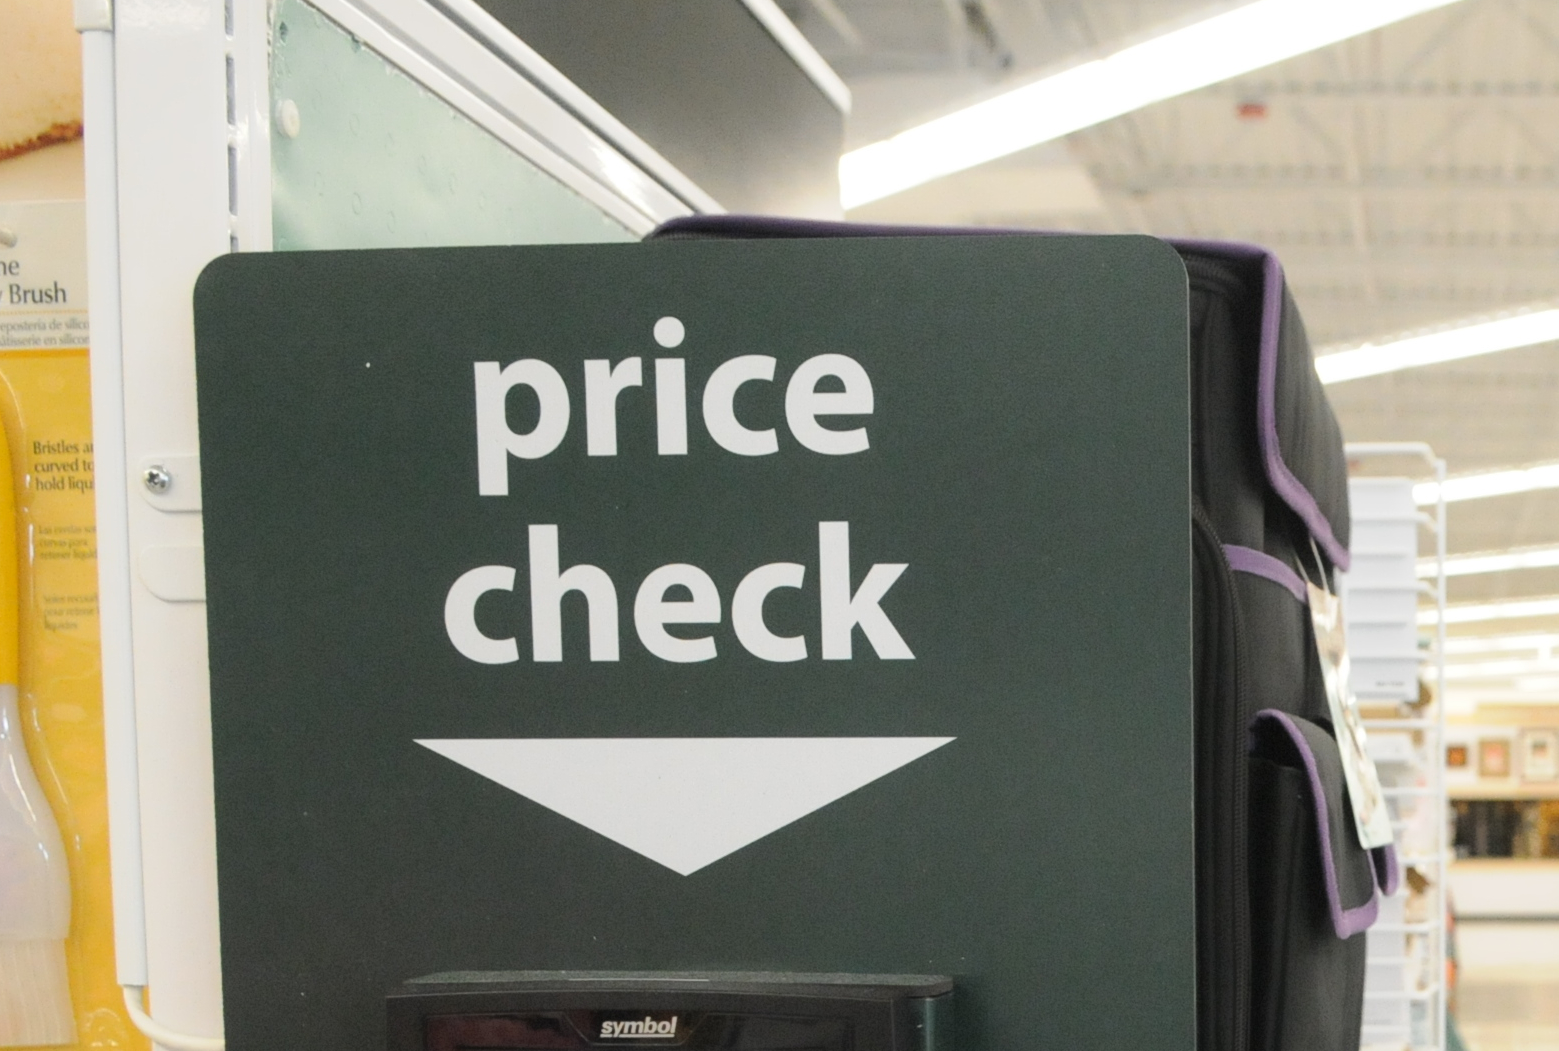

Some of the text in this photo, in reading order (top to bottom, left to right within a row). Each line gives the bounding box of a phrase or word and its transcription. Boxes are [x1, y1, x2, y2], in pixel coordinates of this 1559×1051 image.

[9, 280, 67, 305] Brush
[473, 316, 875, 497] price
[33, 440, 79, 455] Bristles
[34, 457, 79, 473] curved
[35, 475, 65, 491] hold
[444, 520, 916, 665] check
[600, 1016, 678, 1038] symbol
